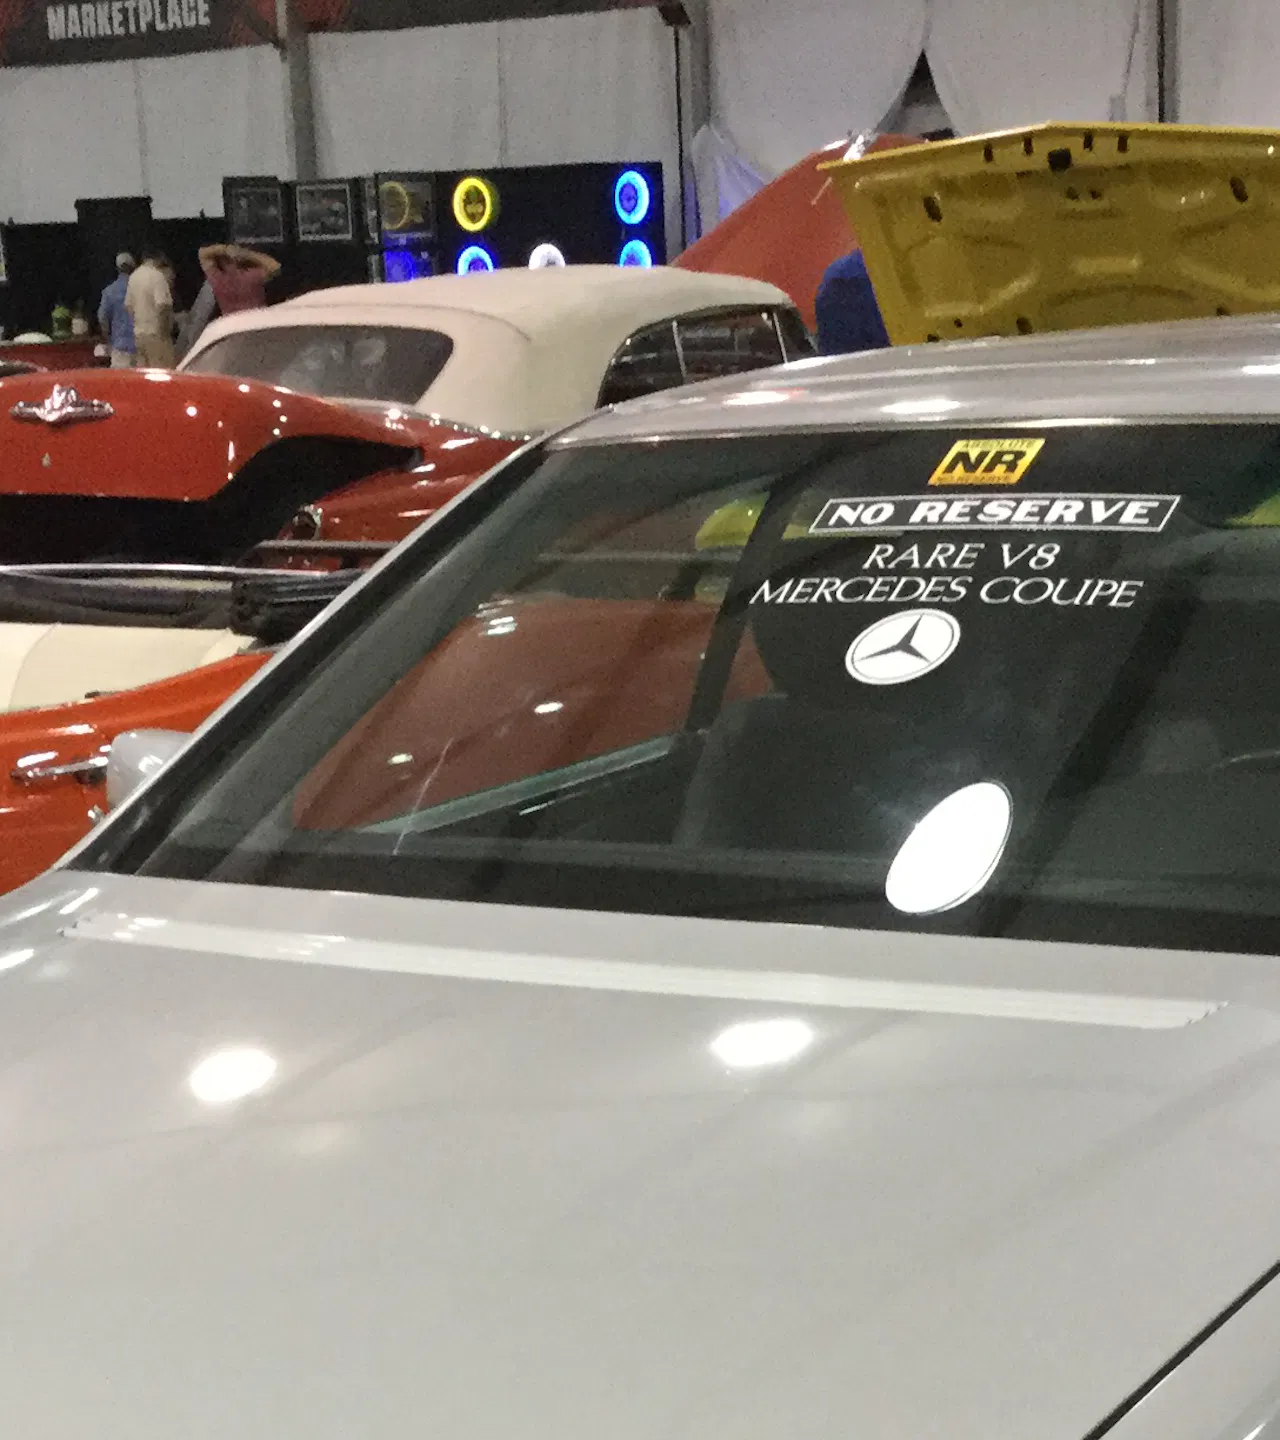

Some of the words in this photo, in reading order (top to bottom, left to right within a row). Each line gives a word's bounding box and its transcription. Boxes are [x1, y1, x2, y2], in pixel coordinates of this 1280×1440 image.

[46, 0, 211, 40] MARKETPLACE
[941, 450, 1027, 474] NR
[828, 501, 895, 526] NO
[909, 498, 1159, 526] RESERVE
[862, 543, 985, 571] RARE
[1000, 543, 1061, 570] V8
[749, 576, 972, 605] MERCEDES
[979, 579, 1144, 608] COUPE
